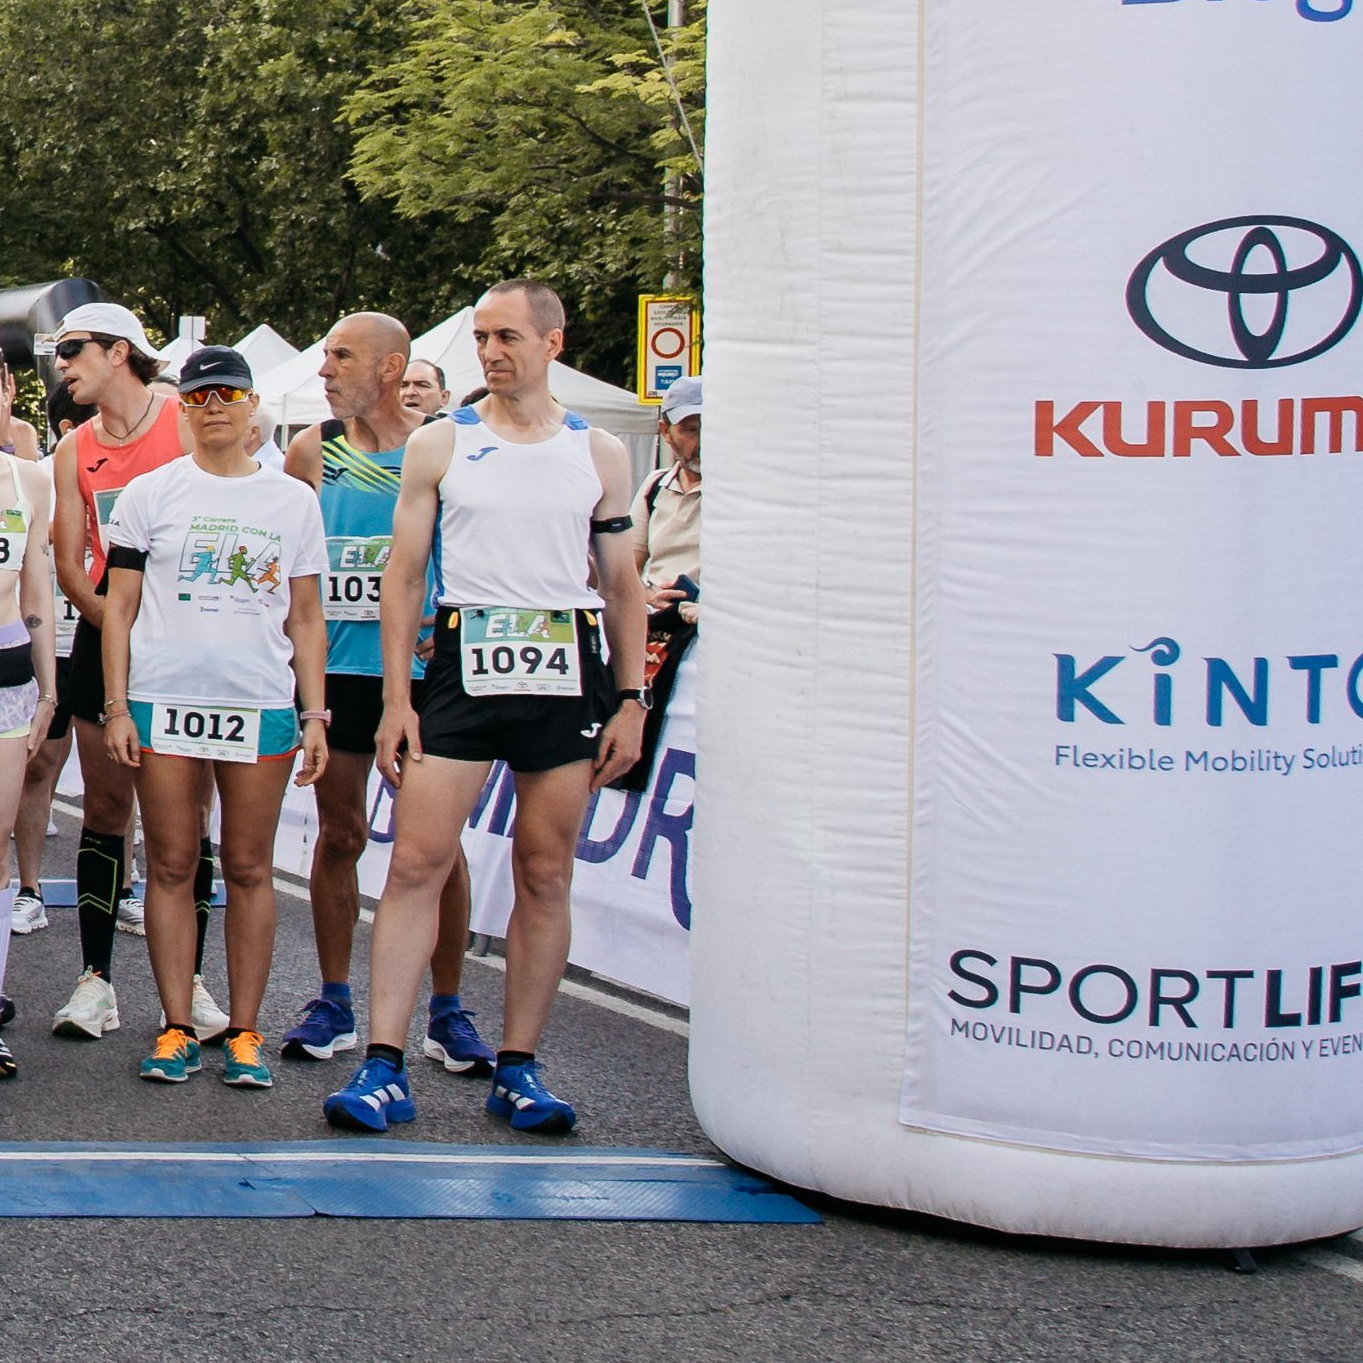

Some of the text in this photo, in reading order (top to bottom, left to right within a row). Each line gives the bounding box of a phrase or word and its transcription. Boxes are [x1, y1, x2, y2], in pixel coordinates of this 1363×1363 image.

[190, 524, 282, 543] MADRID CON LA
[485, 614, 551, 640] ELA
[471, 646, 569, 676] 1094
[164, 708, 245, 742] 1012
[1055, 745, 1175, 772] Flexible
[1185, 749, 1295, 776] Mobility
[951, 1017, 1100, 1060] MOVILIDAD,
[1108, 1035, 1296, 1063] COMUNICACIÓN
[1303, 1038, 1315, 1059] Y
